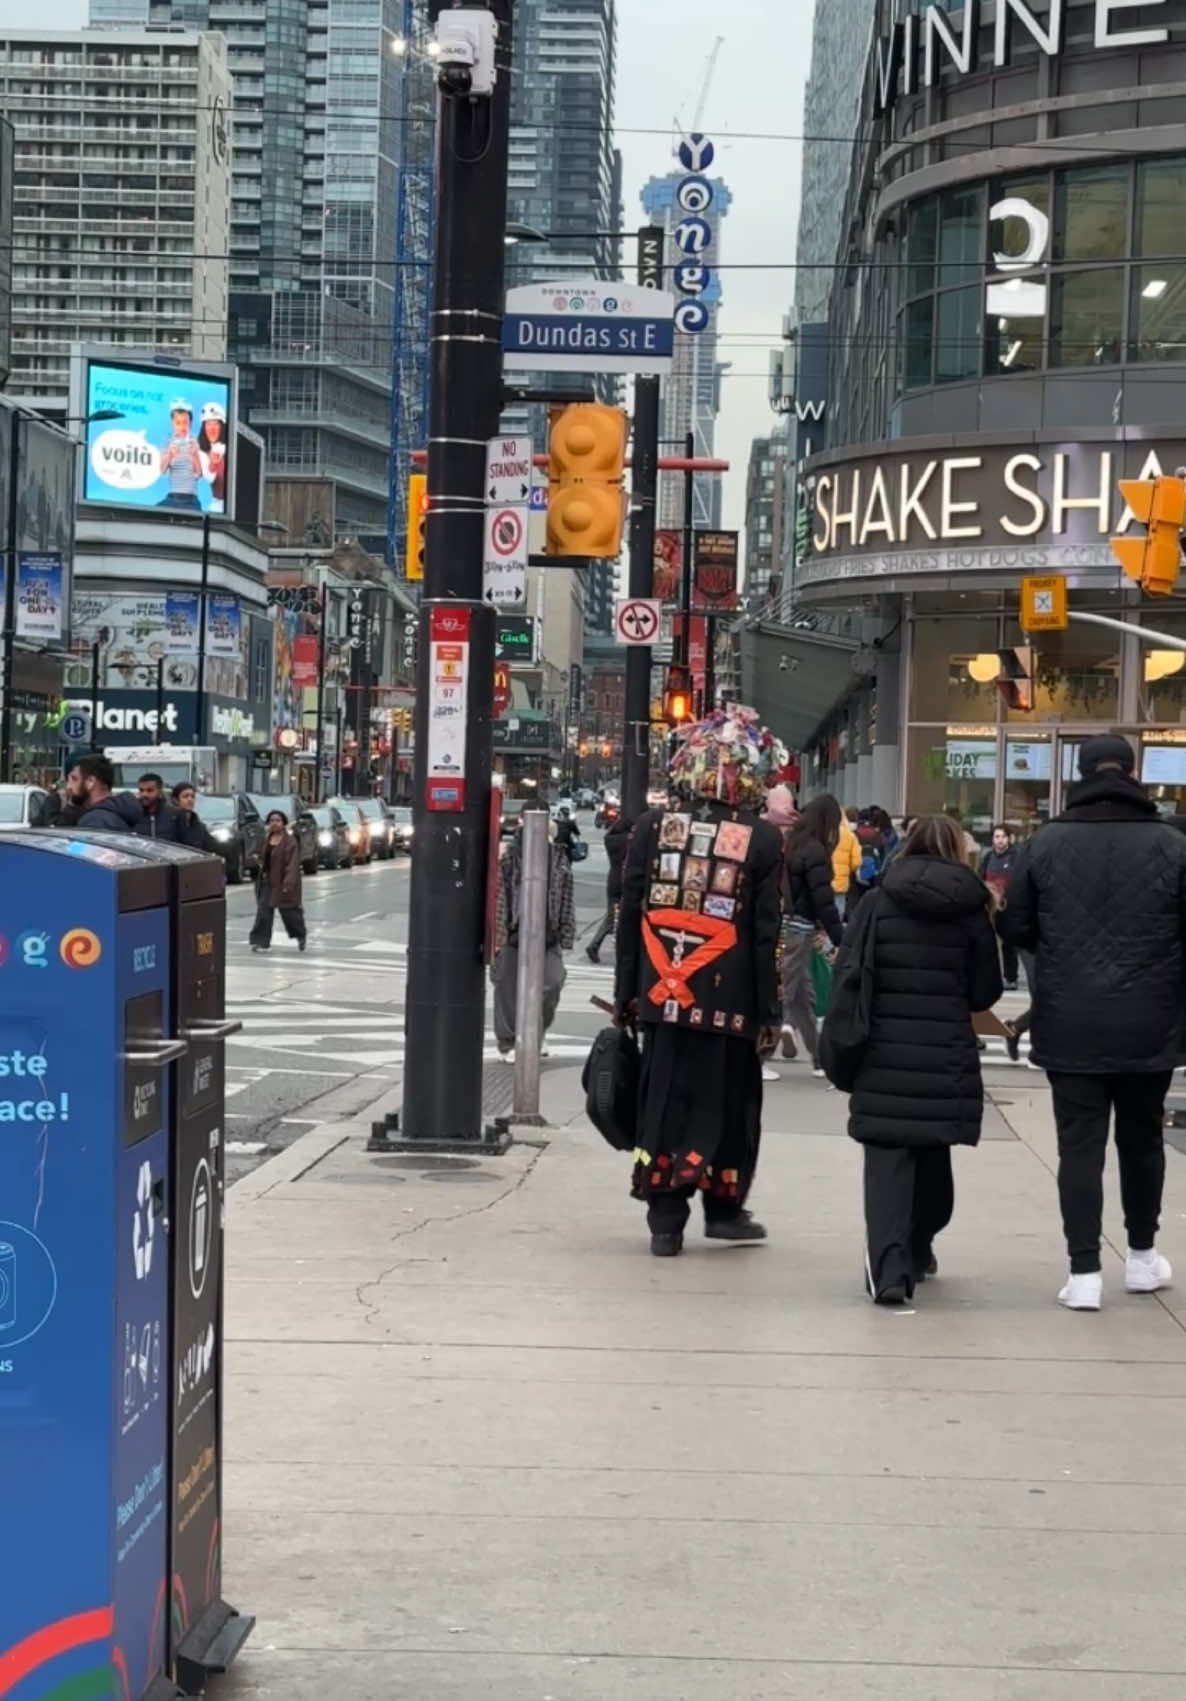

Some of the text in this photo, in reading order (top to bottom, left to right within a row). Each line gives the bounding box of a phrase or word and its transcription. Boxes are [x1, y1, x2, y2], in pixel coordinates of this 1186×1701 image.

[518, 320, 656, 349] Dundas St E
[102, 444, 153, 467] voilà
[502, 441, 516, 456] NO
[490, 460, 529, 480] STANDING
[813, 456, 983, 553] SHAKE
[880, 553, 940, 574] SHAKES
[0, 1092, 69, 1121] ace!
